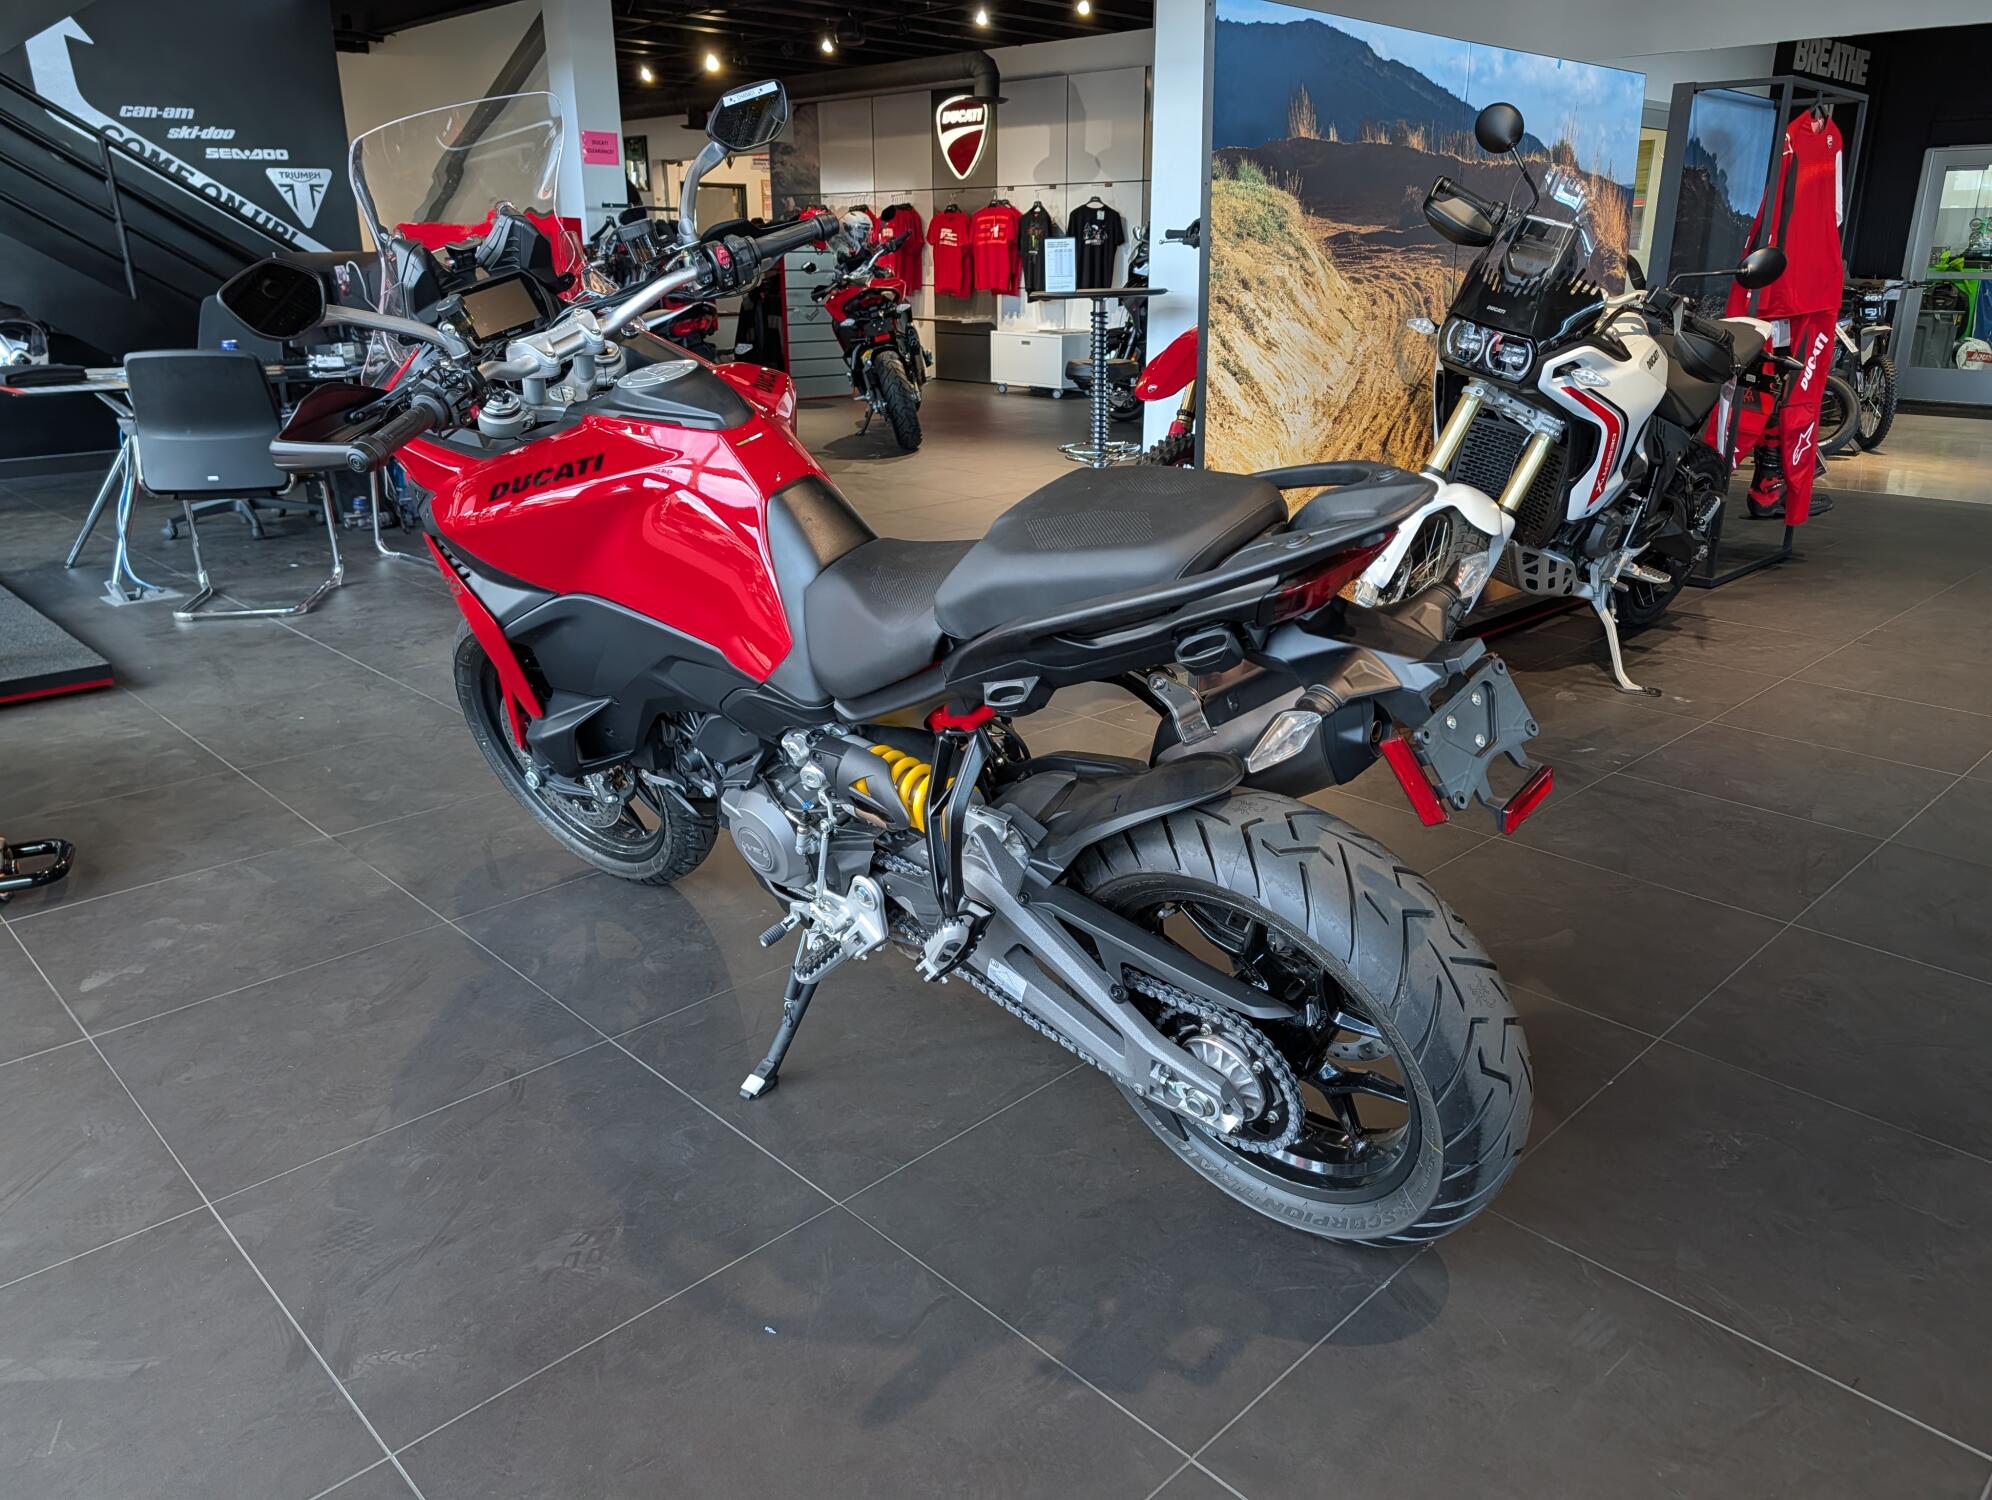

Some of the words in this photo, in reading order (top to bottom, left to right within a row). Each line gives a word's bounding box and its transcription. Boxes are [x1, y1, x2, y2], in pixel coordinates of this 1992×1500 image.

[1793, 39, 1871, 86] BREATHE
[119, 105, 195, 120] can-am
[941, 108, 983, 124] DUCATI
[167, 126, 236, 140] ski-doo
[278, 171, 322, 180] TRIUMPH
[1486, 304, 1507, 315] DUCATI
[1646, 349, 1660, 370] DUCATI
[1800, 331, 1829, 392] DUCATI
[488, 453, 605, 502] DUCATI
[1262, 1195, 1396, 1230] SCORPION
